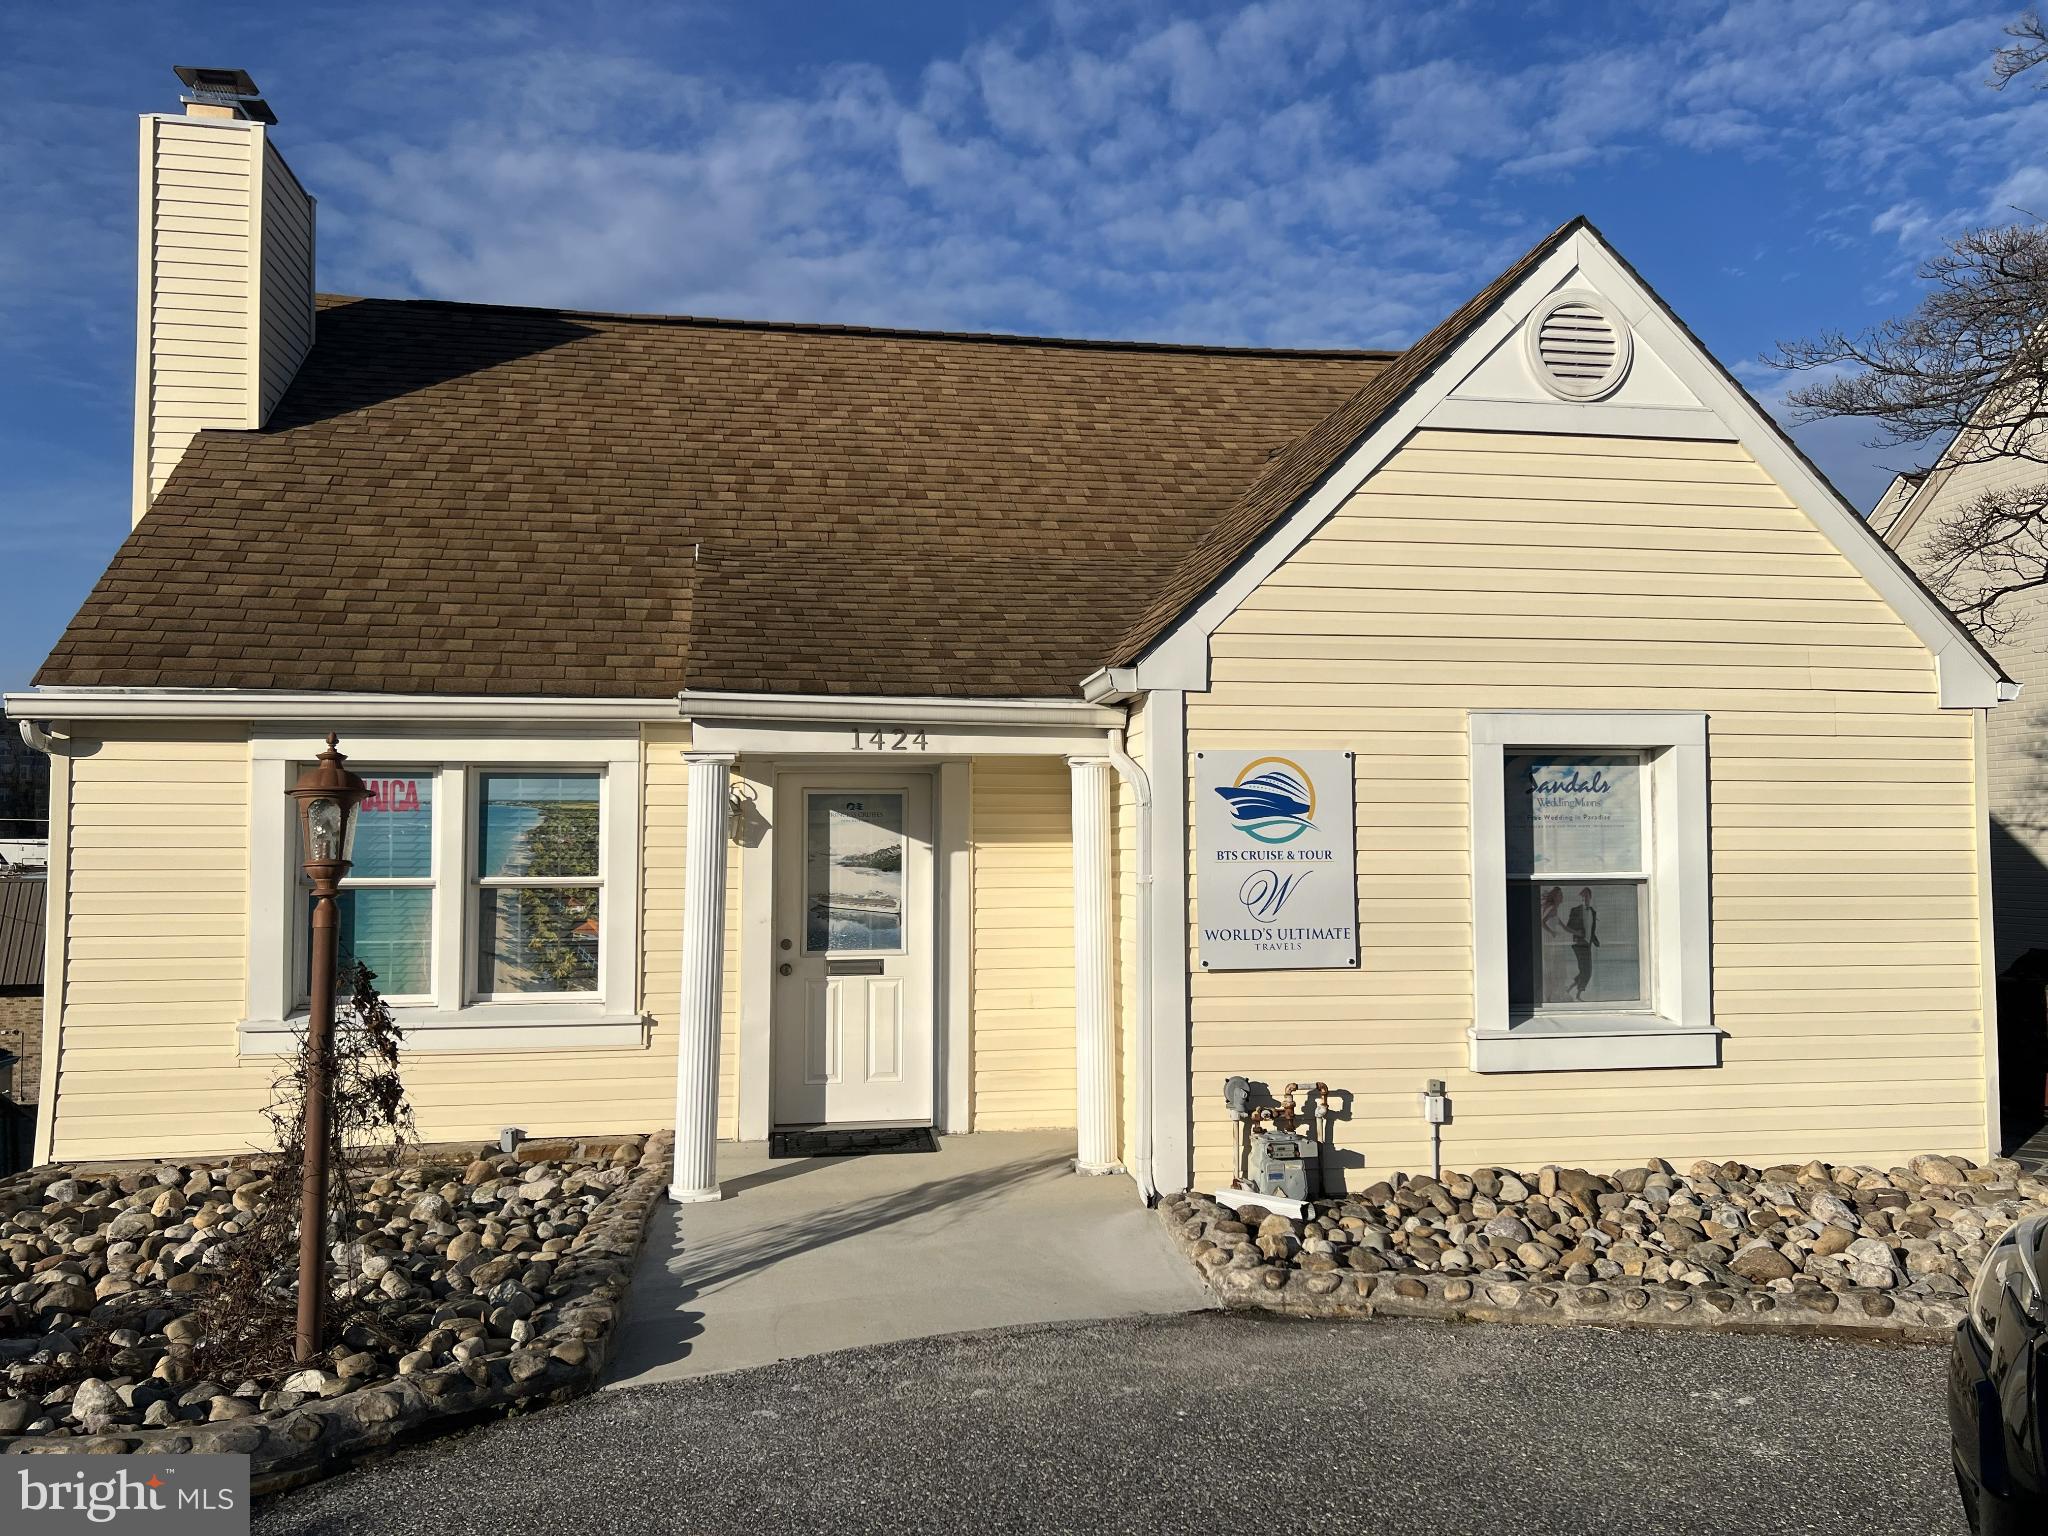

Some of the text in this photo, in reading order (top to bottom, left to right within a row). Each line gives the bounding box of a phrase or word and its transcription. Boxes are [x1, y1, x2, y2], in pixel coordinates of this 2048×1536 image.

[851, 728, 928, 751] 1424
[1526, 770, 1611, 794] Sandals
[361, 780, 420, 812] AICA
[1537, 797, 1601, 809] WeddingMoons
[1216, 850, 1333, 861] BTS CRUISE & TOUR
[1239, 869, 1314, 923] W
[1204, 927, 1351, 941] WORLD'S ULTIMATE
[1254, 942, 1302, 950] TRAVELS
